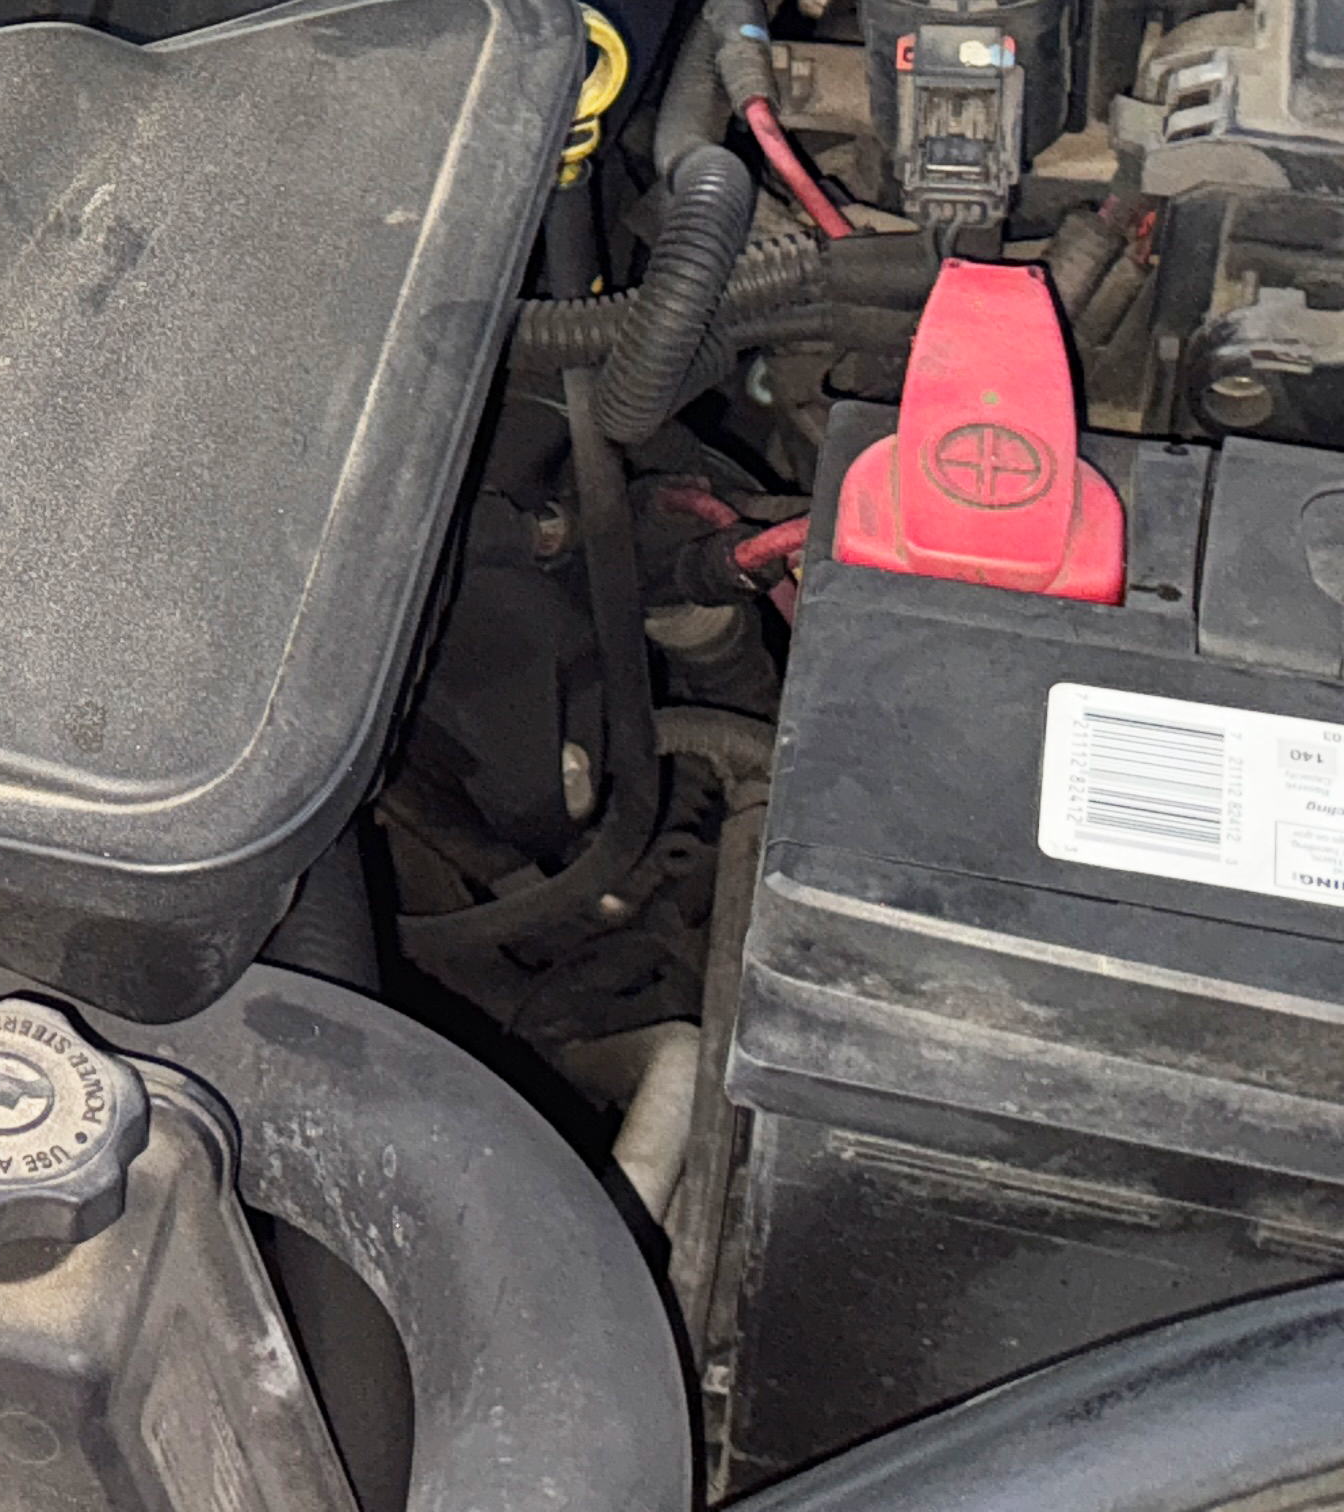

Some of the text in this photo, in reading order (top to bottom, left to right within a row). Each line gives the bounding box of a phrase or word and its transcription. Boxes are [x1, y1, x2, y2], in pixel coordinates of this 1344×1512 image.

[1289, 749, 1324, 765] 140
[70, 1051, 107, 1125] POWER
[22, 1144, 72, 1173] USE
